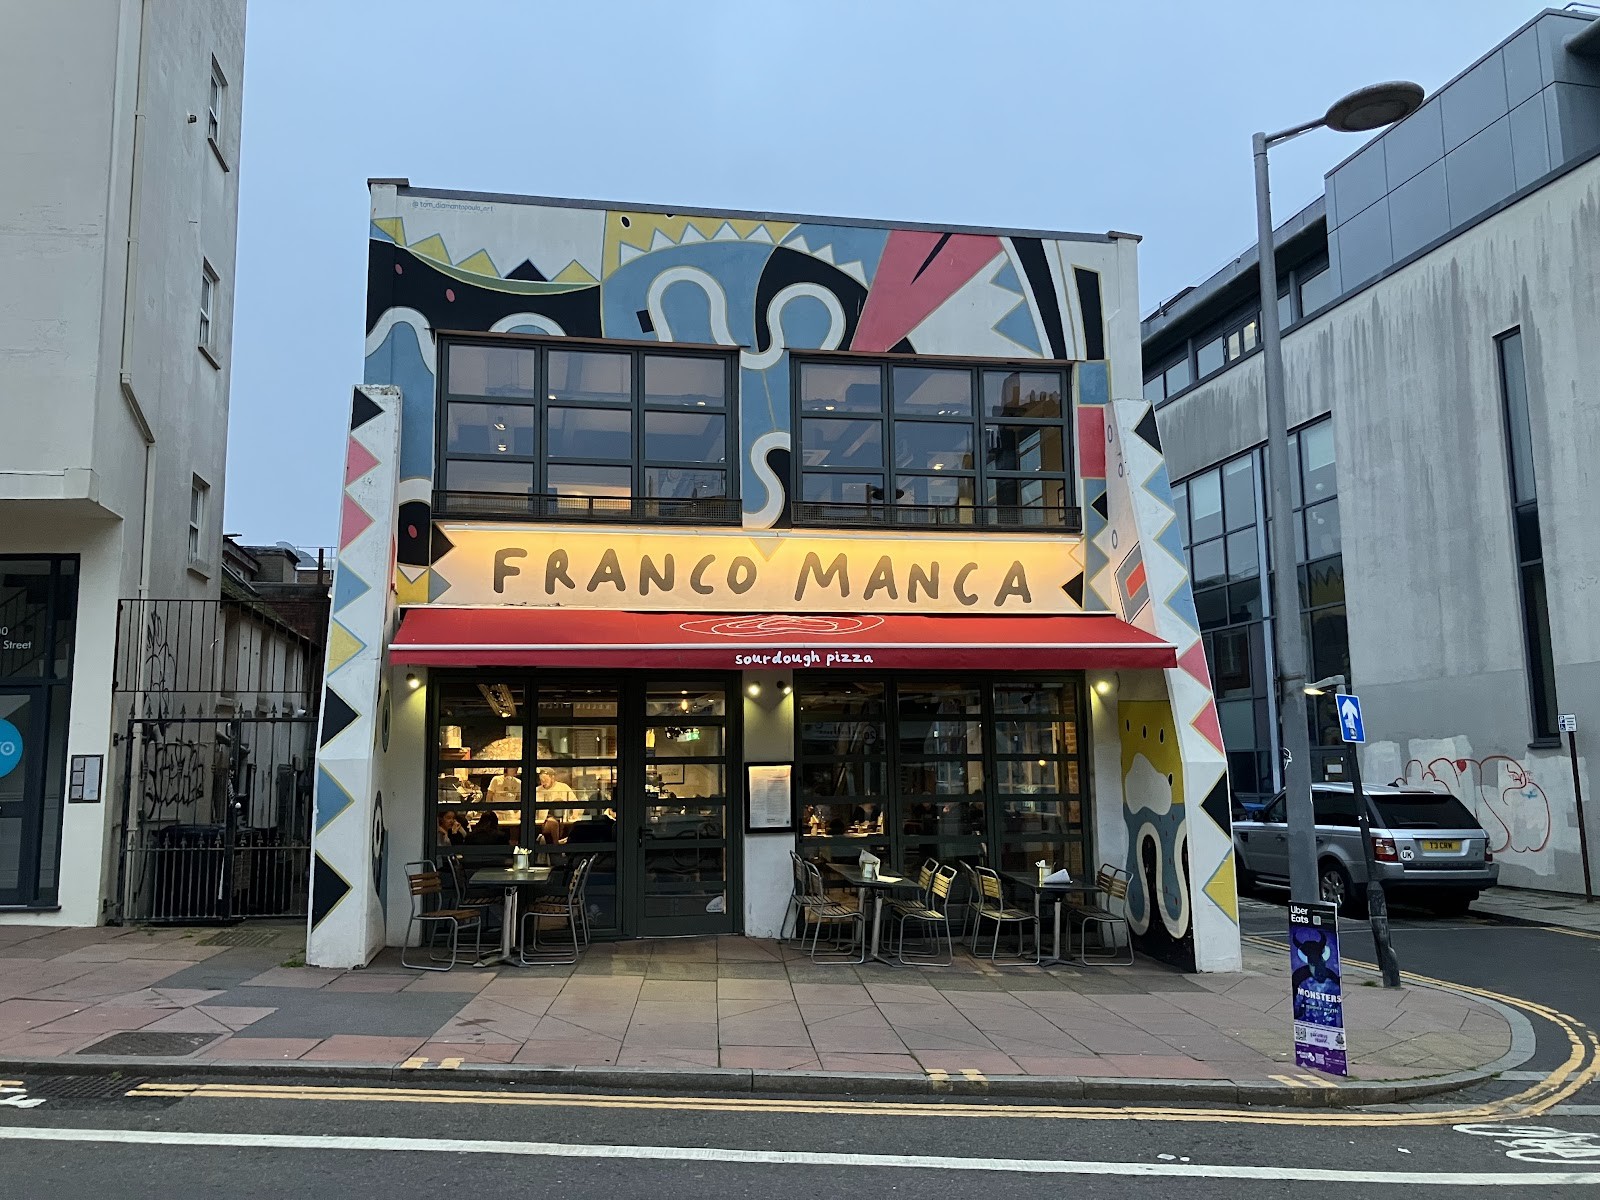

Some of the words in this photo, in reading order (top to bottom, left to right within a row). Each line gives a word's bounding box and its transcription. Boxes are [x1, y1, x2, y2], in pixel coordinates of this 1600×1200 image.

[493, 547, 757, 596] FRANCO
[794, 551, 1032, 607] MANCA
[3, 640, 31, 650] Street
[735, 650, 821, 667] sourdough
[826, 651, 874, 667] pizza
[1402, 851, 1412, 859] UK
[1290, 905, 1309, 915] Uber
[1291, 914, 1309, 924] Eats
[1297, 987, 1342, 1003] MONSTERS
